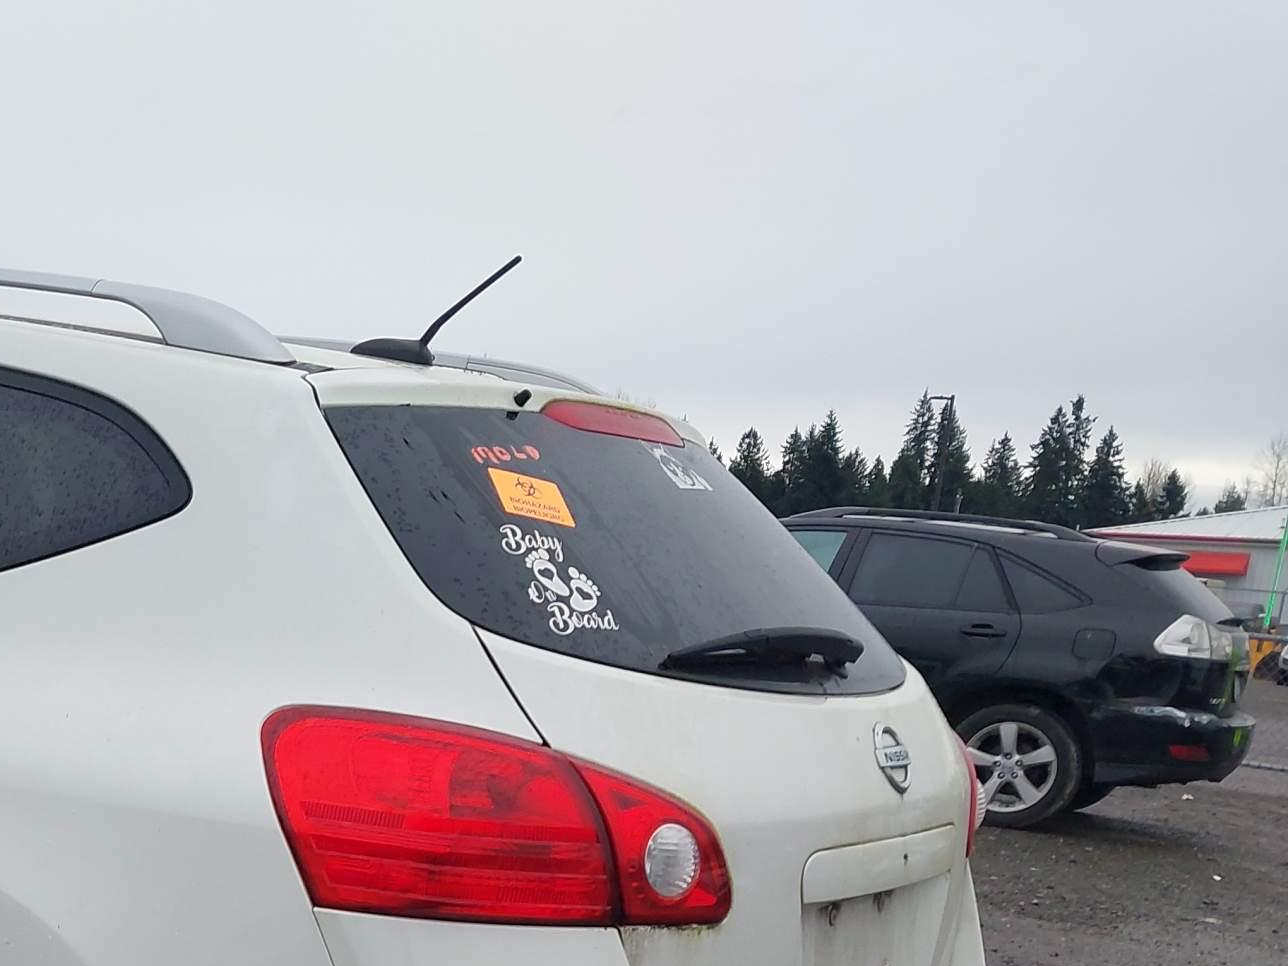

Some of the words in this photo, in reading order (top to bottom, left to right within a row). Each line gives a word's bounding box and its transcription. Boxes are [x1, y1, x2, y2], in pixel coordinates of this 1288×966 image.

[472, 445, 540, 464] MOLD
[499, 524, 564, 562] Baby
[528, 580, 557, 603] On
[547, 602, 619, 635] Board
